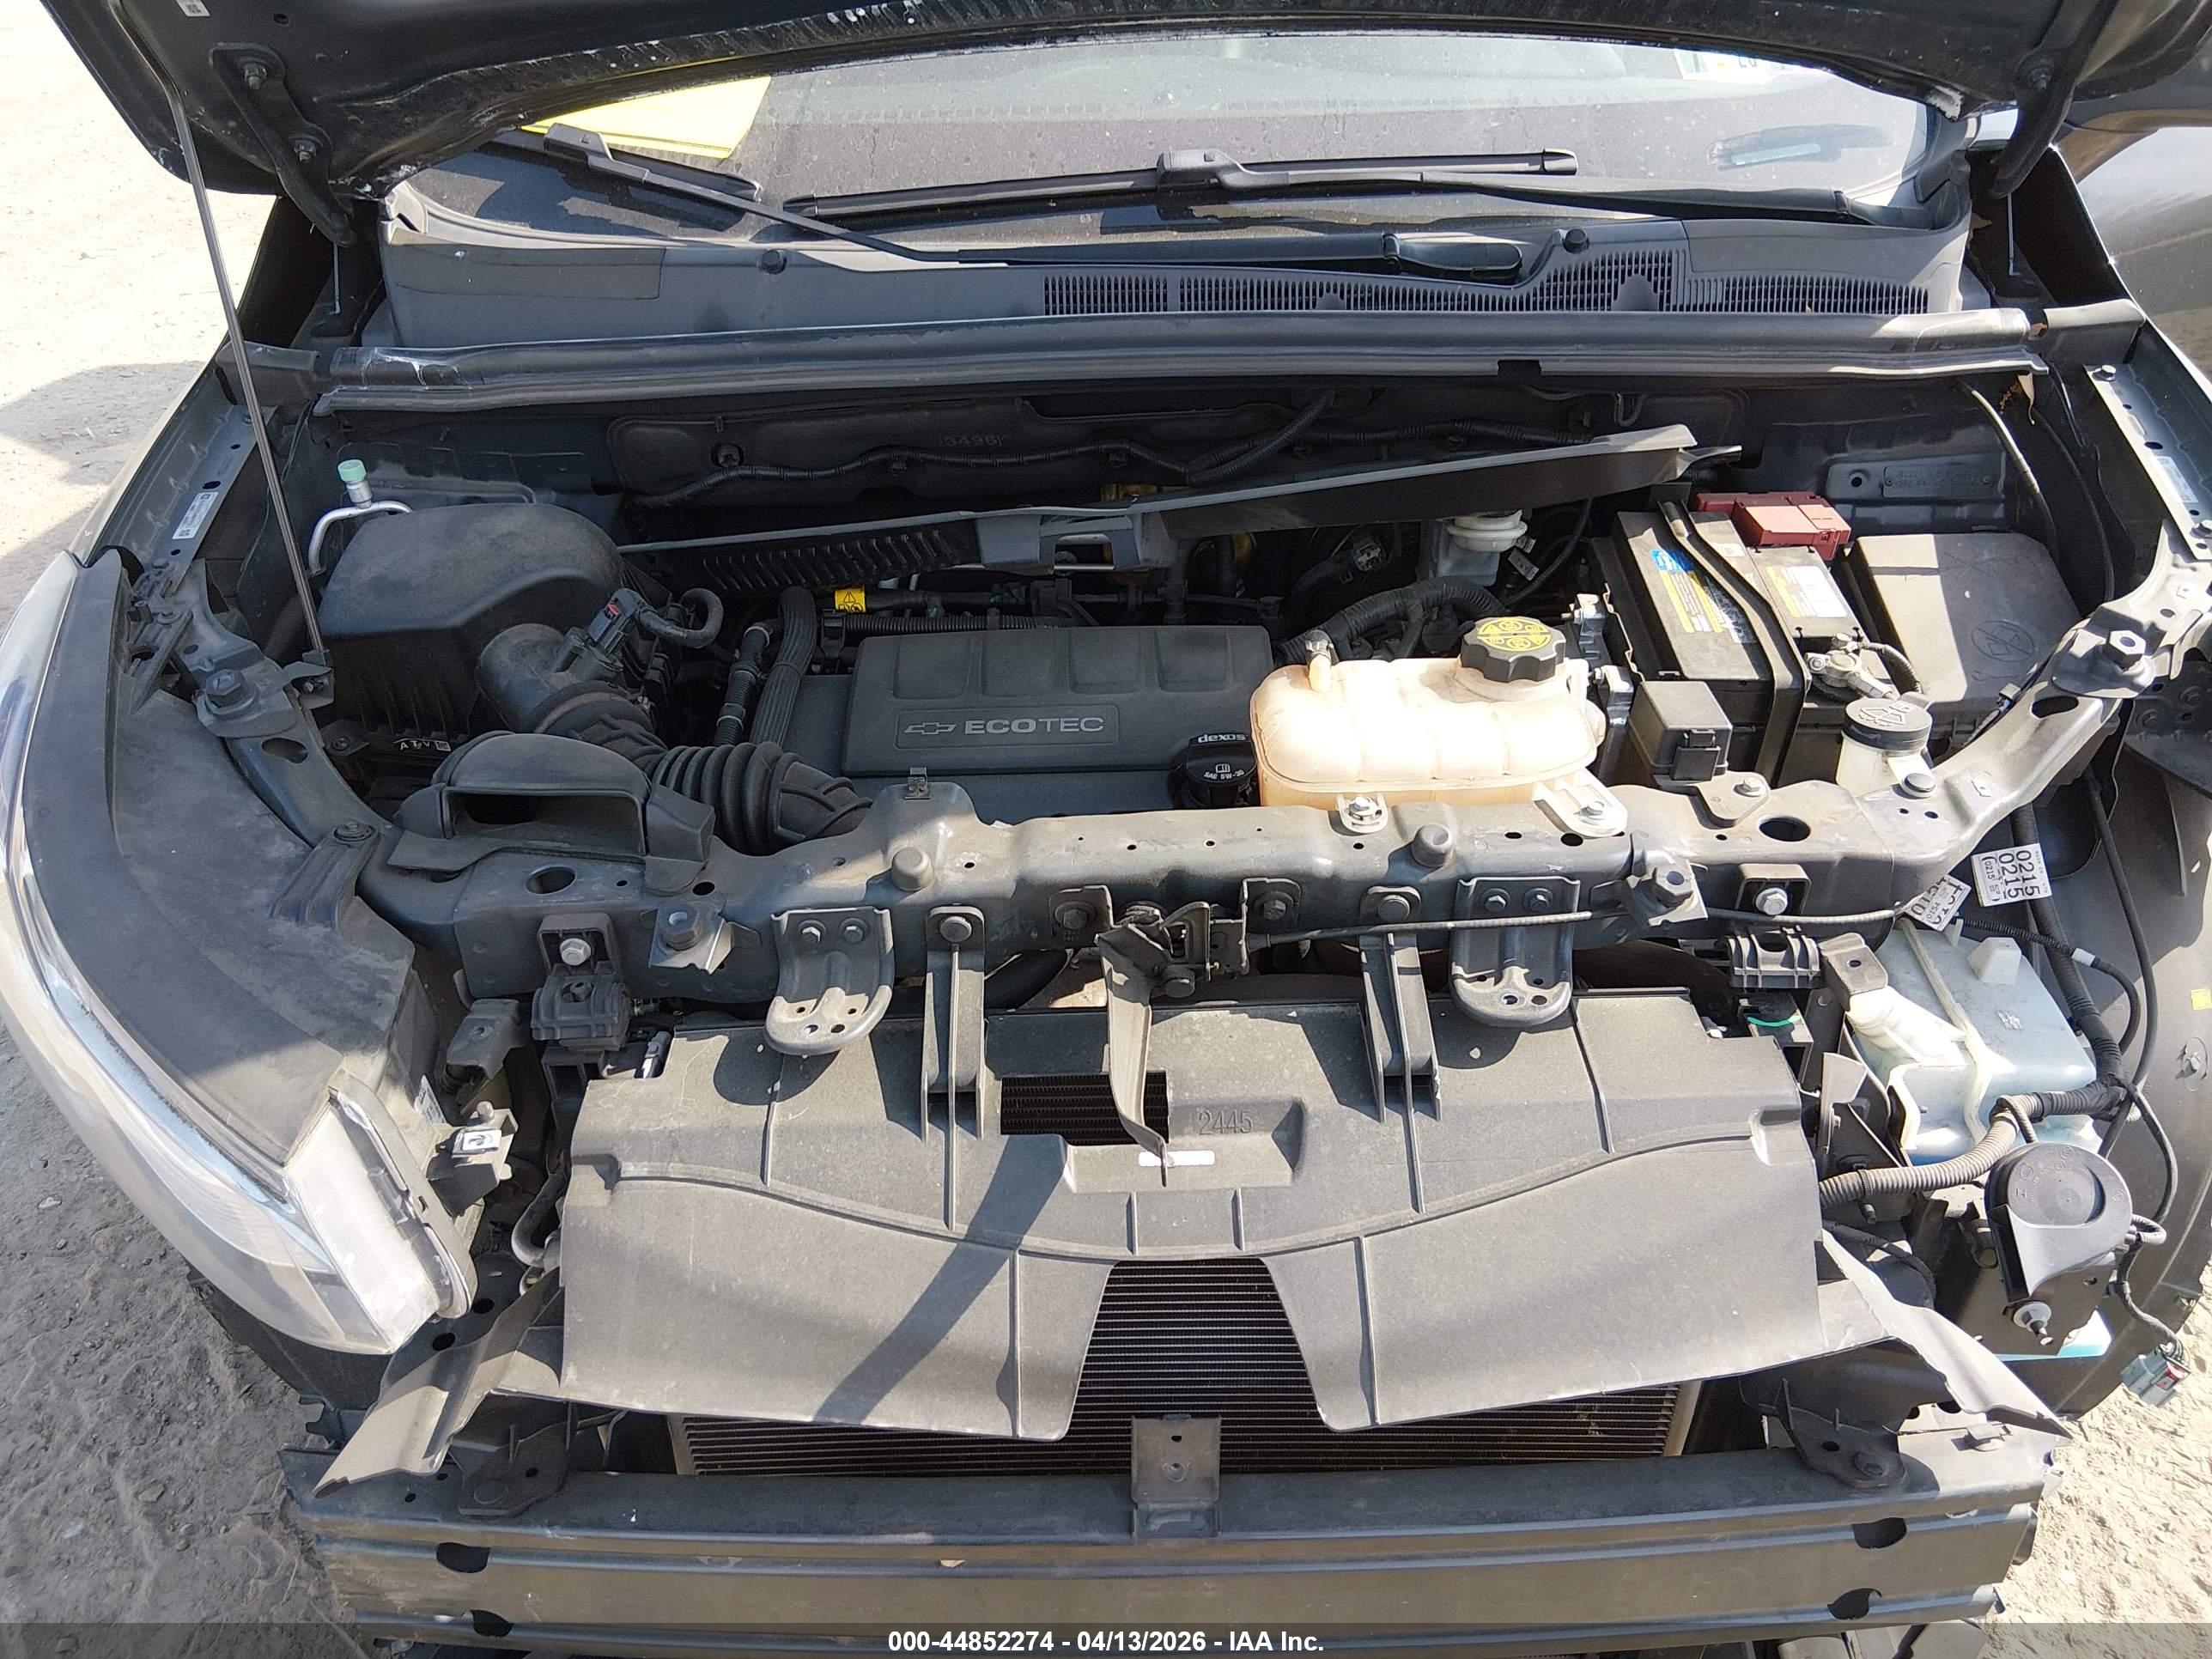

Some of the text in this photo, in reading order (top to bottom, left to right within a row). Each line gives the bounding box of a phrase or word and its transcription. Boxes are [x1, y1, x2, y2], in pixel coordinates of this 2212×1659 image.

[963, 715, 1105, 735] ECOTEC
[1197, 733, 1246, 744] dexos
[1204, 771, 1218, 780] SAE
[1984, 860, 1996, 880] 0215
[1998, 853, 2025, 898] 0215
[2015, 850, 2040, 896] 0215
[1198, 1109, 1254, 1135] 2445
